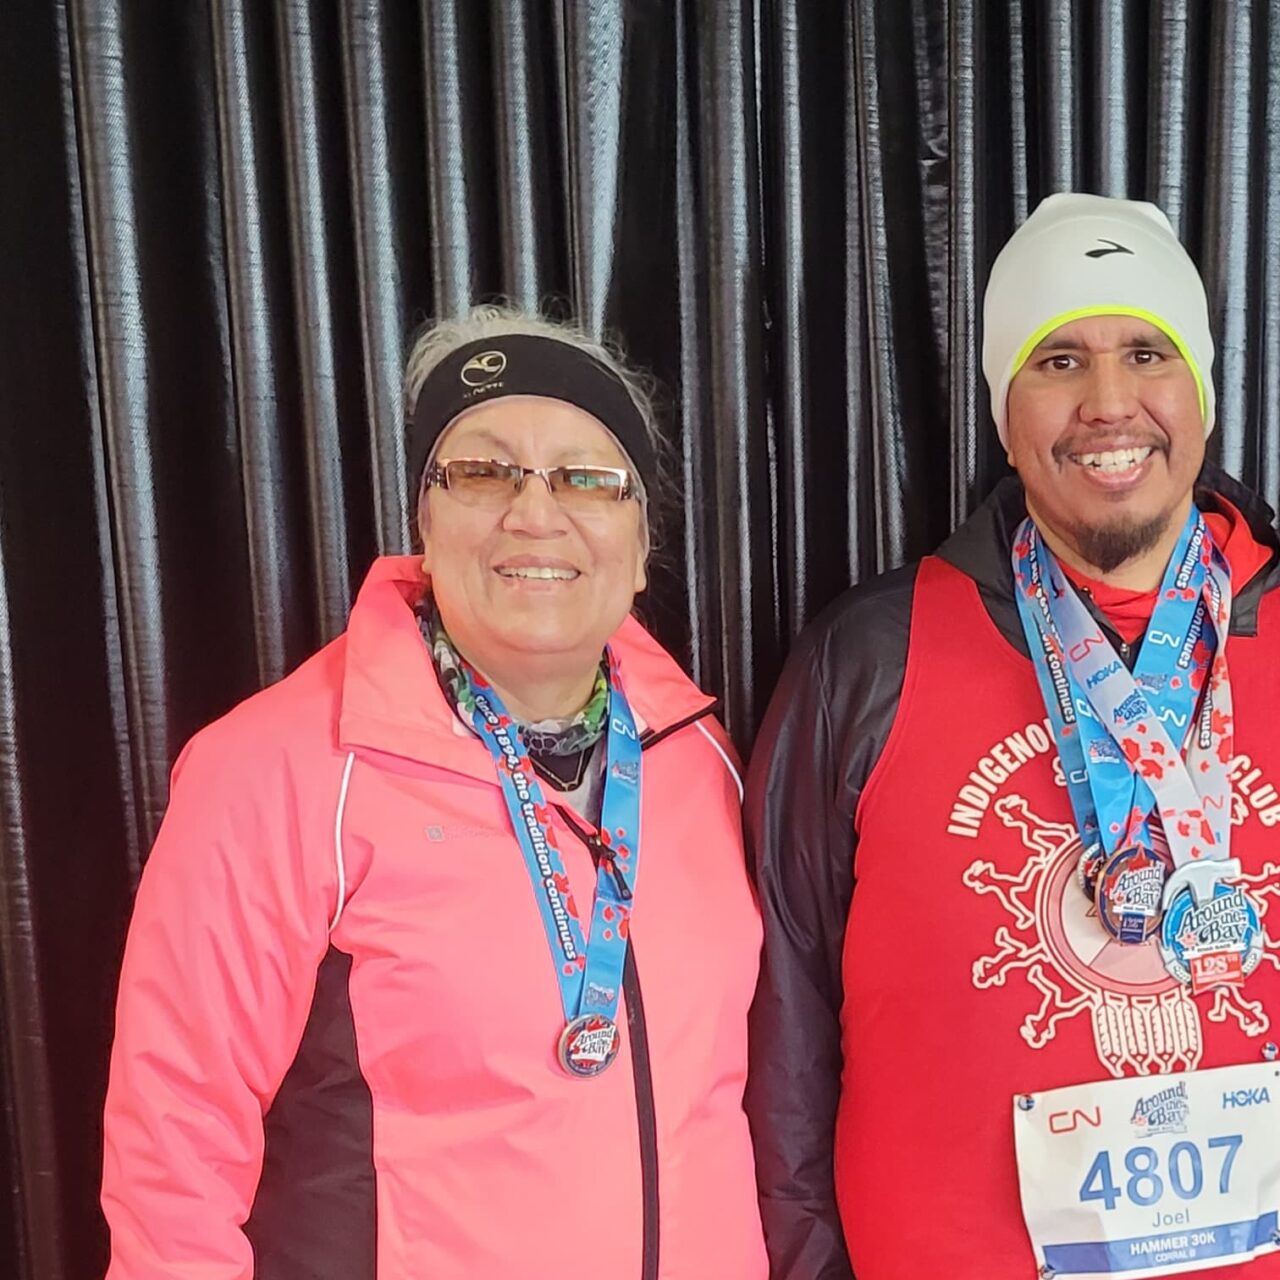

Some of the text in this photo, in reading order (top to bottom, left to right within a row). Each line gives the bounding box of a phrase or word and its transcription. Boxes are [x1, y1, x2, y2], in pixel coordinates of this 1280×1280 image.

[1176, 530, 1204, 588] continues
[1070, 629, 1105, 662] CN
[1148, 629, 1180, 648] CN
[1178, 600, 1207, 668] continues
[1048, 653, 1075, 723] continues
[1086, 660, 1122, 689] HOKA
[947, 717, 1057, 839] INDIGENO
[494, 728, 519, 769] 1894,
[513, 772, 530, 801] the
[522, 802, 553, 876] tradition
[545, 877, 578, 961] continues
[1113, 863, 1162, 895] Around
[1126, 886, 1160, 907] Bay
[1177, 887, 1245, 939] Around
[1219, 908, 1246, 925] the
[1199, 920, 1245, 944] Bay
[1130, 1080, 1187, 1123] Around
[1222, 1087, 1271, 1109] HOKA
[1049, 1105, 1102, 1134] CN
[1147, 1106, 1186, 1126] Bay
[1078, 1134, 1244, 1211] 4807
[1151, 1207, 1190, 1228] Joel
[1129, 1231, 1216, 1256] HAMMER 30K
